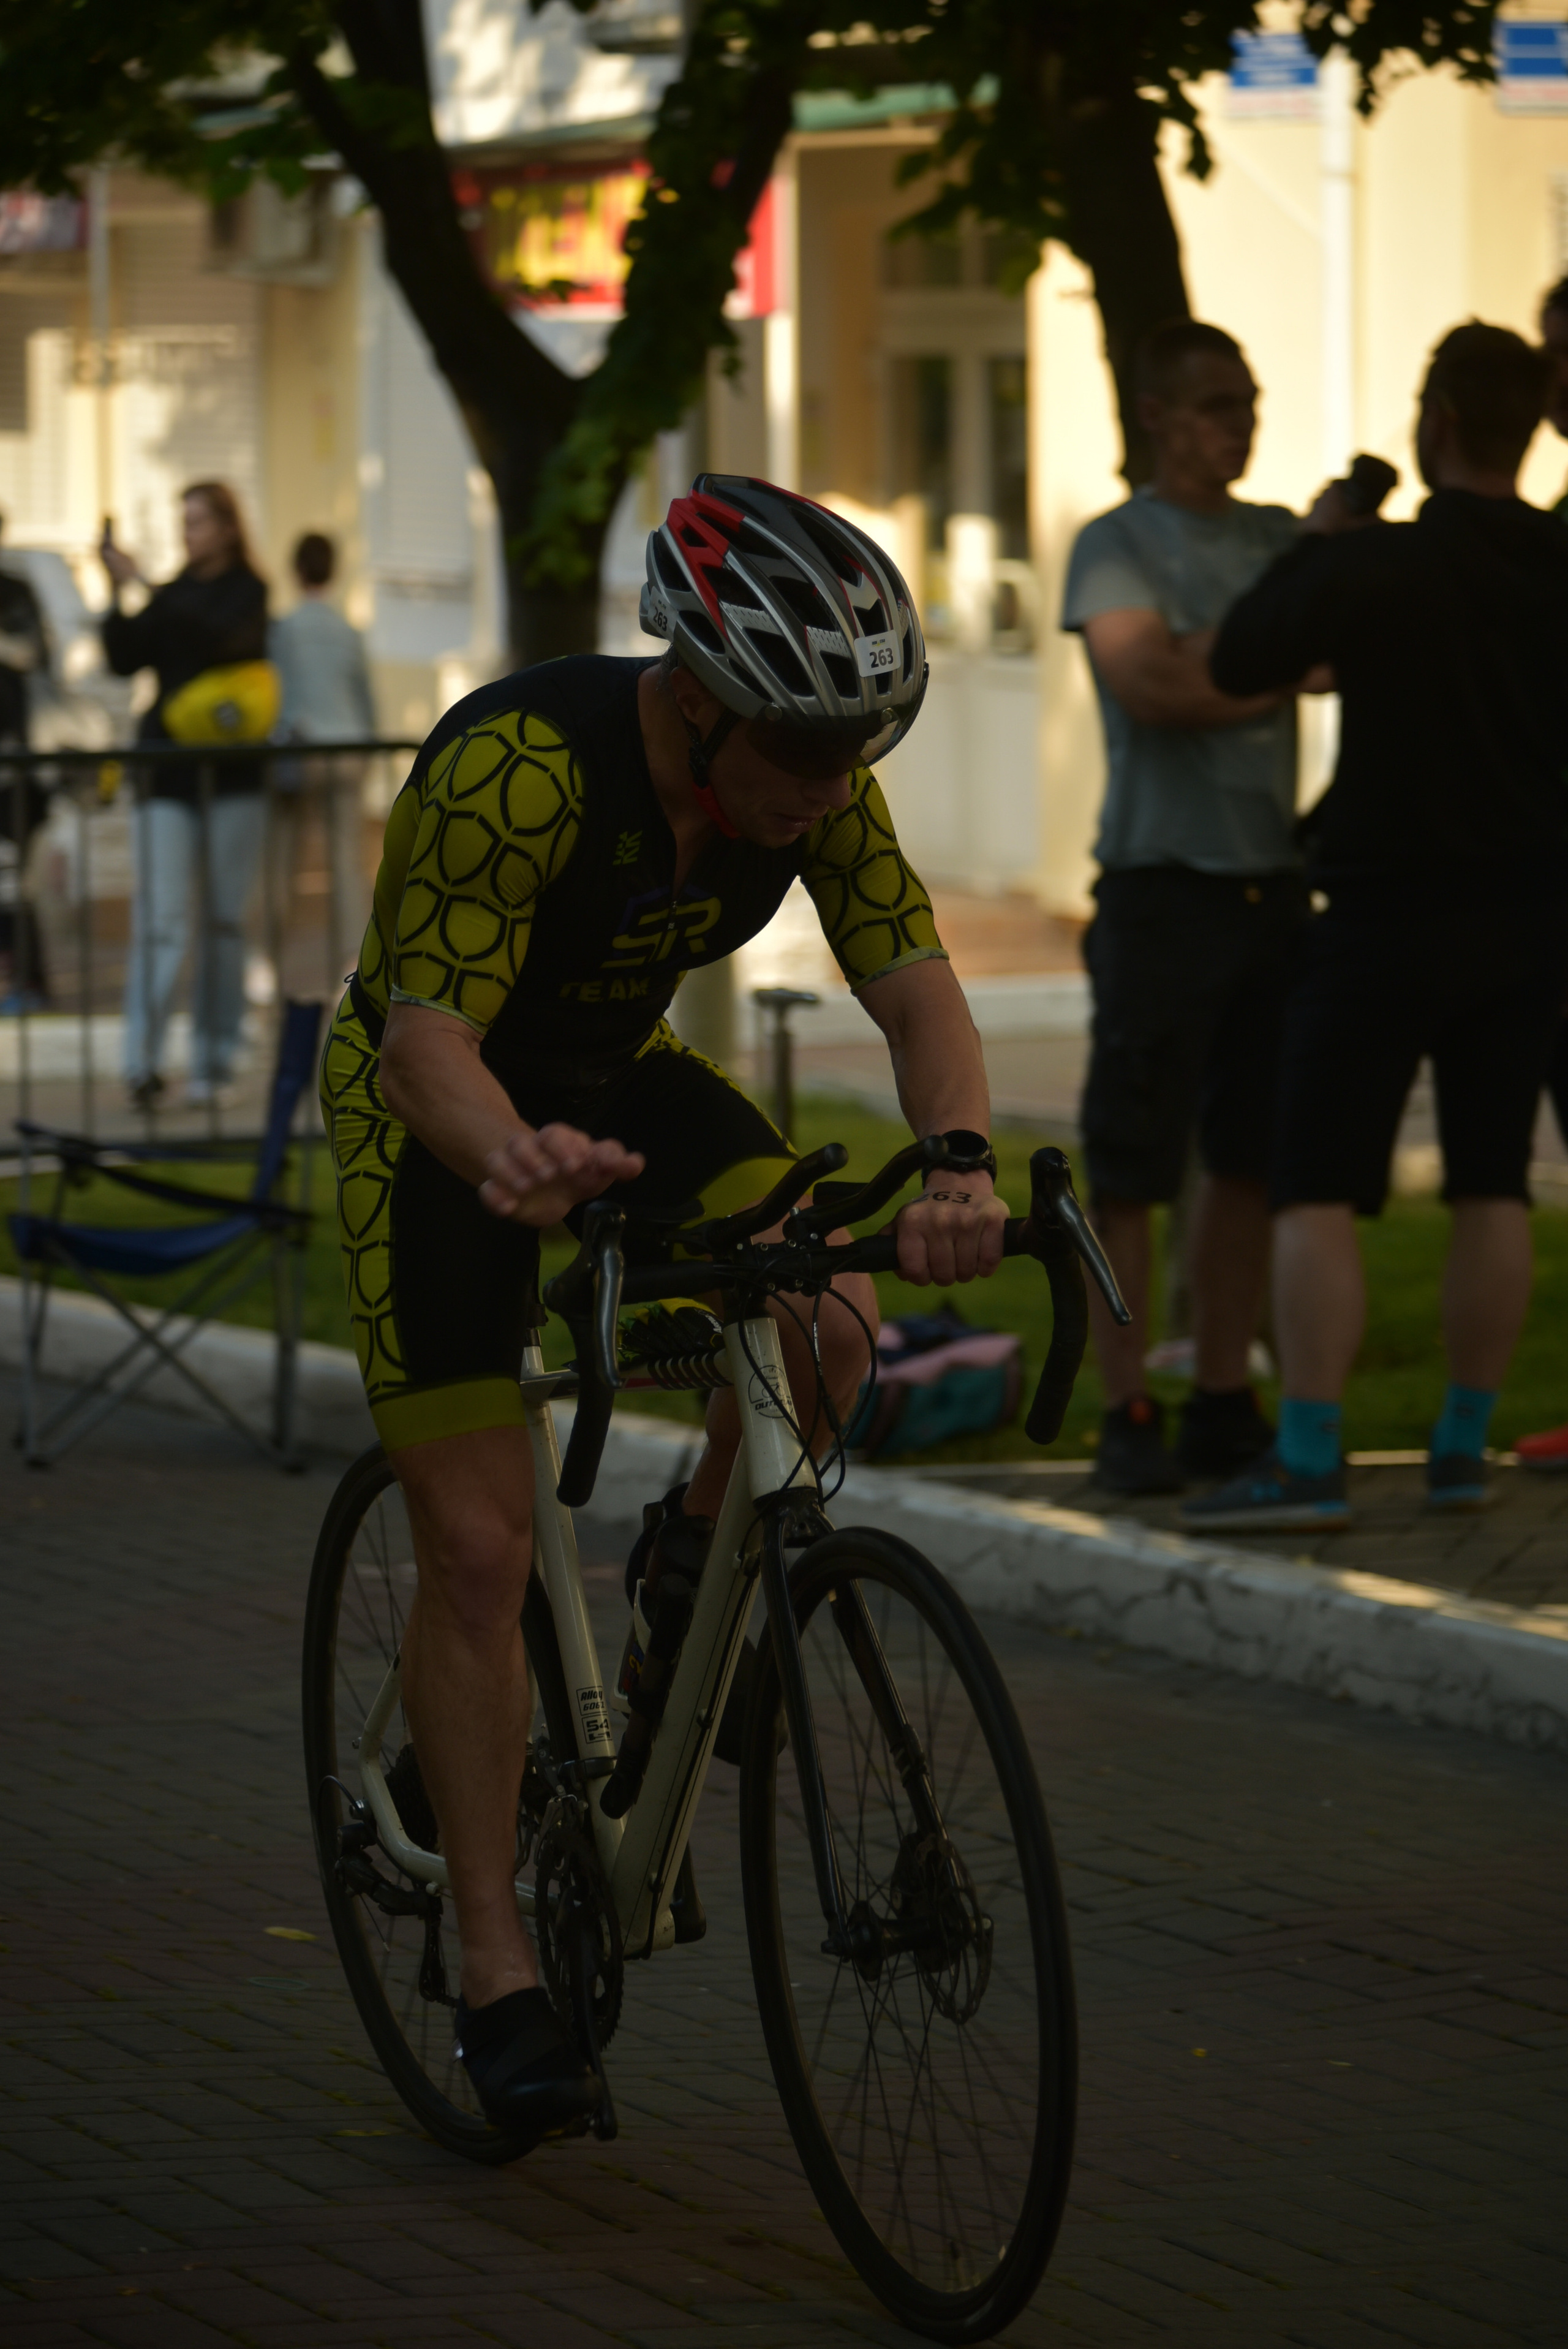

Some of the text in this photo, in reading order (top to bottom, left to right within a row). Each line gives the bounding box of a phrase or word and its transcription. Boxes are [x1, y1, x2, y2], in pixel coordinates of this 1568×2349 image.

[653, 606, 668, 632] 263
[869, 648, 894, 668] 263
[558, 977, 651, 1004] TEAM
[586, 1718, 609, 1733] 54
